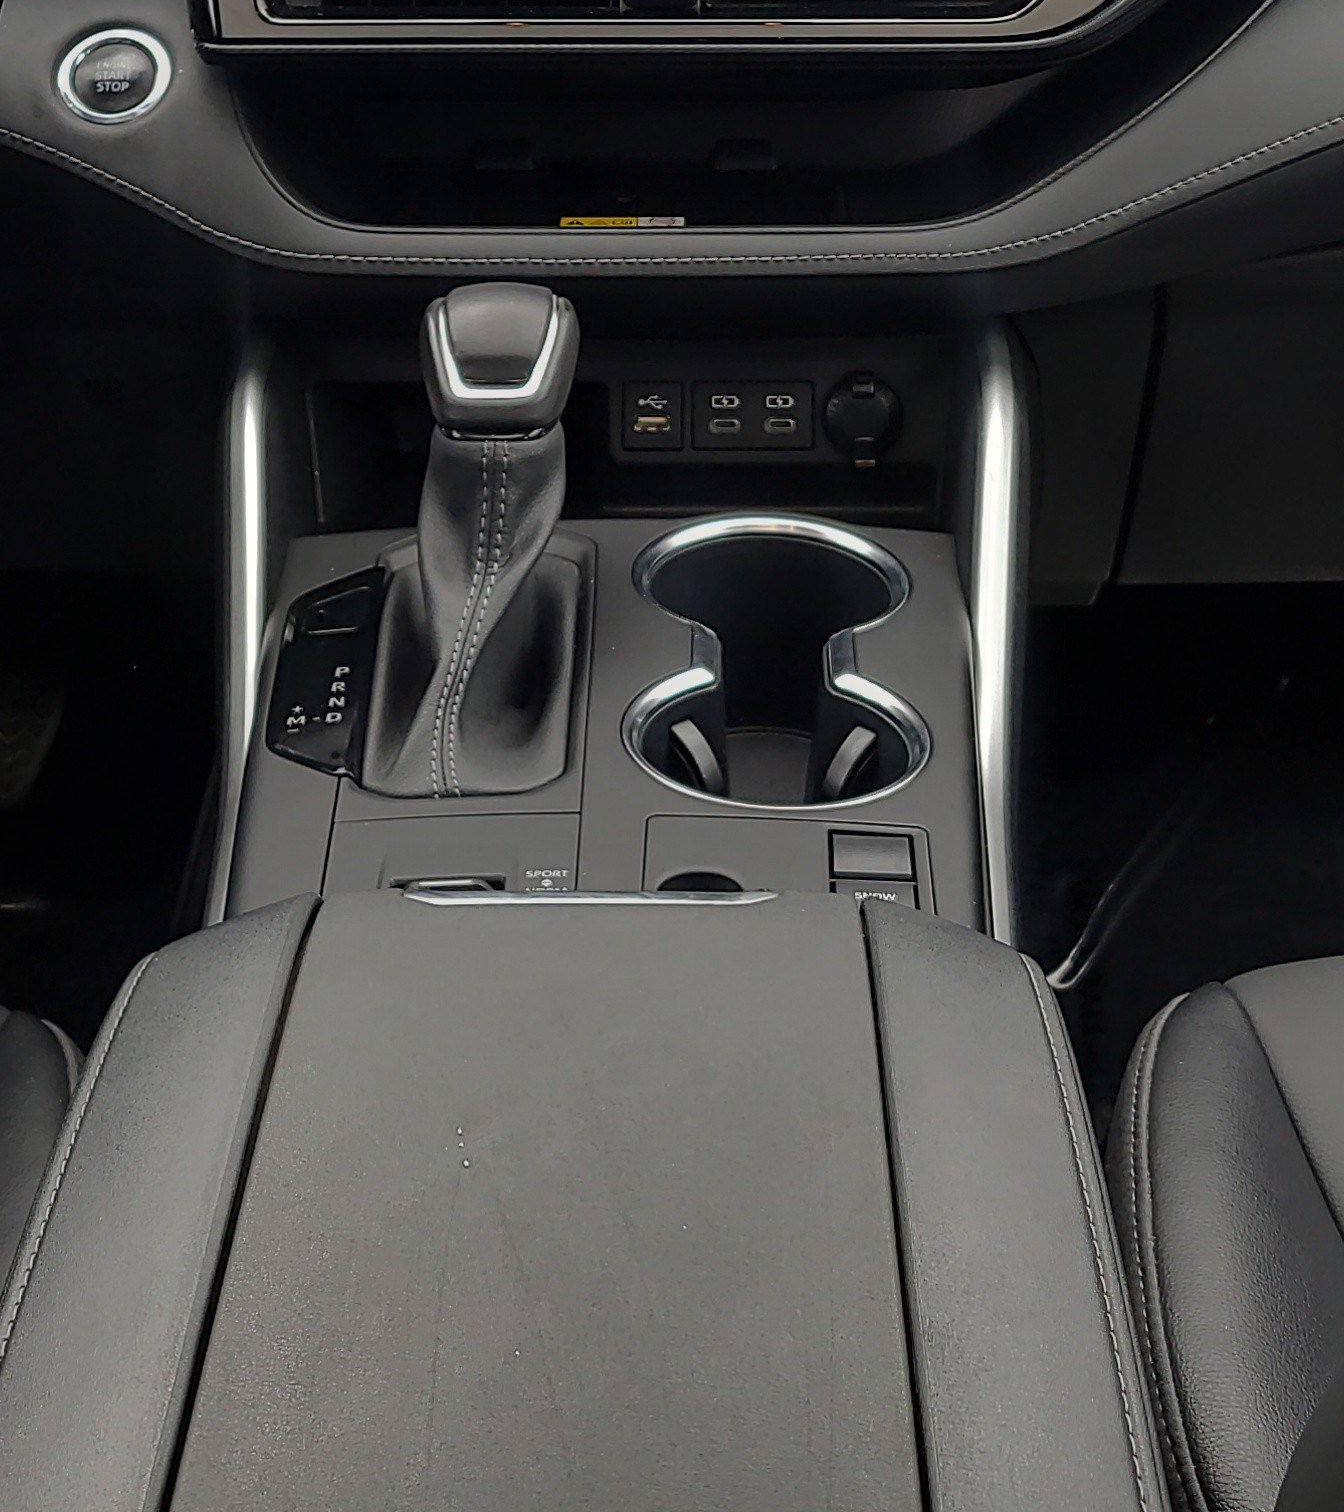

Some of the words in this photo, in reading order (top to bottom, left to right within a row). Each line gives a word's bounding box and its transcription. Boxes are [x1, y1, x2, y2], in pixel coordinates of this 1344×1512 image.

[95, 70, 131, 80] START
[96, 81, 130, 93] STOP
[334, 666, 351, 679] P
[331, 681, 347, 694] R
[328, 696, 345, 708] N
[286, 715, 306, 727] M
[325, 712, 343, 724] D
[526, 869, 570, 878] SPORT
[854, 891, 896, 901] SNOW
